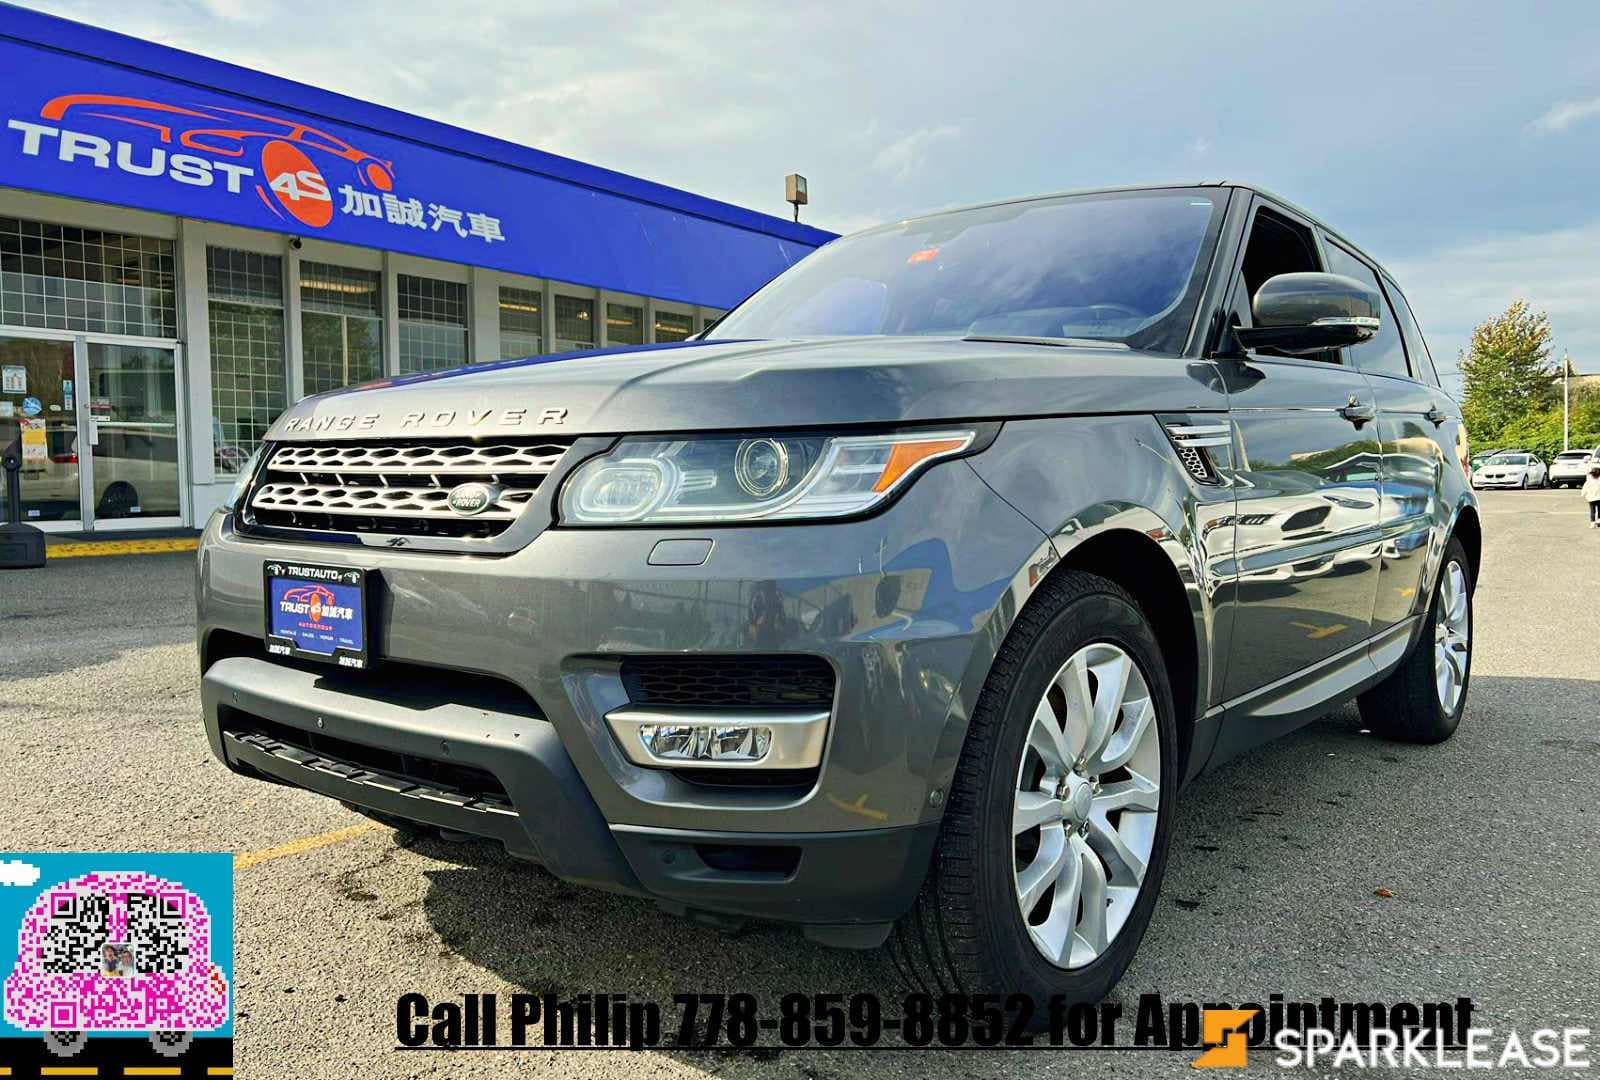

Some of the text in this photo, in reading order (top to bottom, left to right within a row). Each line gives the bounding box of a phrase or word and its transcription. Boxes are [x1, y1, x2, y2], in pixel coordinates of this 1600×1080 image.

[8, 119, 332, 202] TRUST 4S
[338, 184, 505, 243] 加誠汽車
[284, 407, 569, 433] RANGE ROVER
[288, 566, 338, 580] TRUSTAUTO
[280, 601, 311, 614] TRUST
